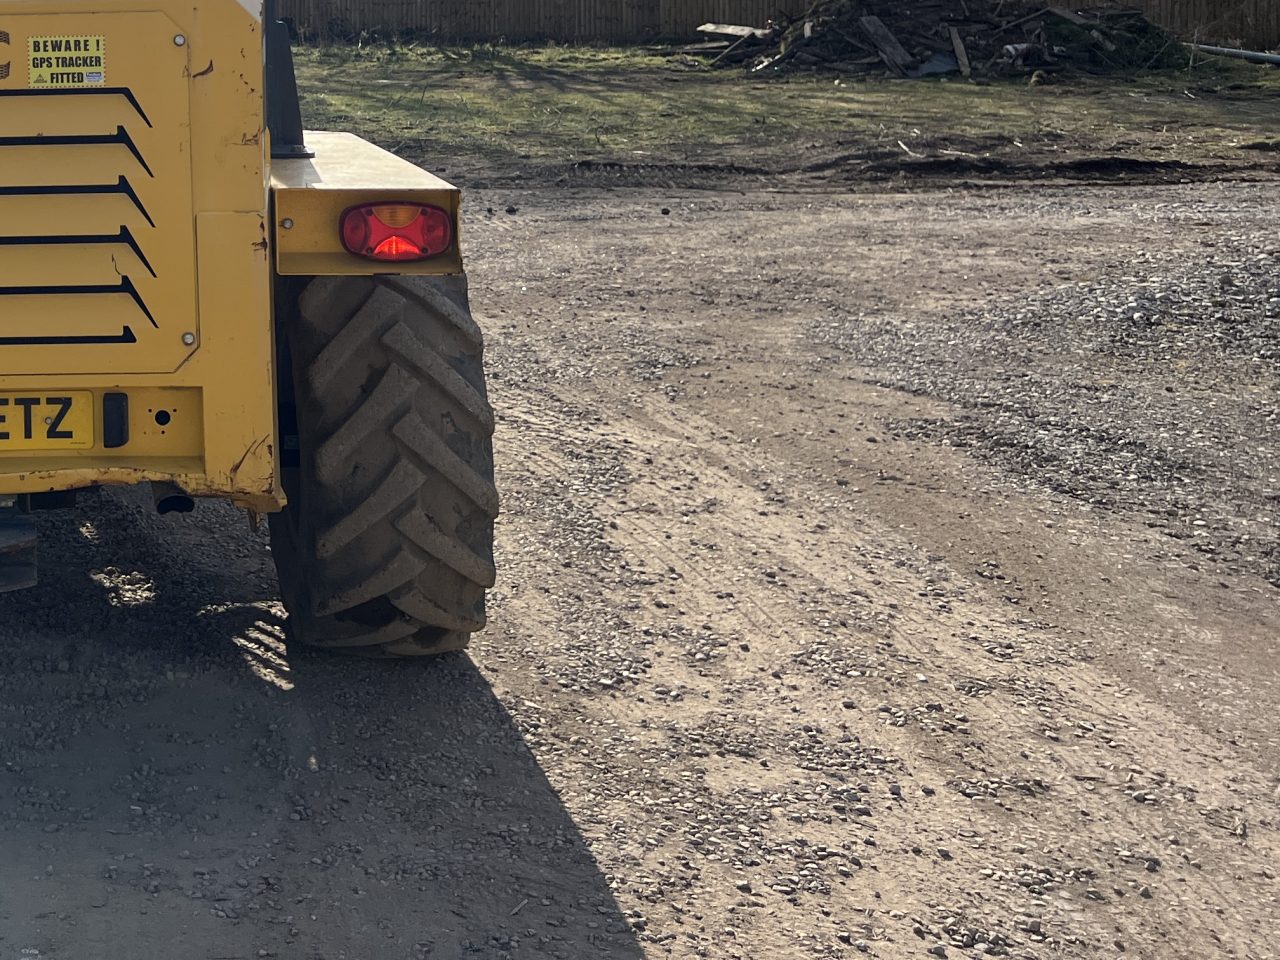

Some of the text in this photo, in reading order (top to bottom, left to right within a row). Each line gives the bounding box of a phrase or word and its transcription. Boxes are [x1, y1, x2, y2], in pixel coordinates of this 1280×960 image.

[33, 39, 90, 52] BEWARE
[32, 55, 102, 68] GPS TRACKER
[50, 72, 84, 84] FITTED
